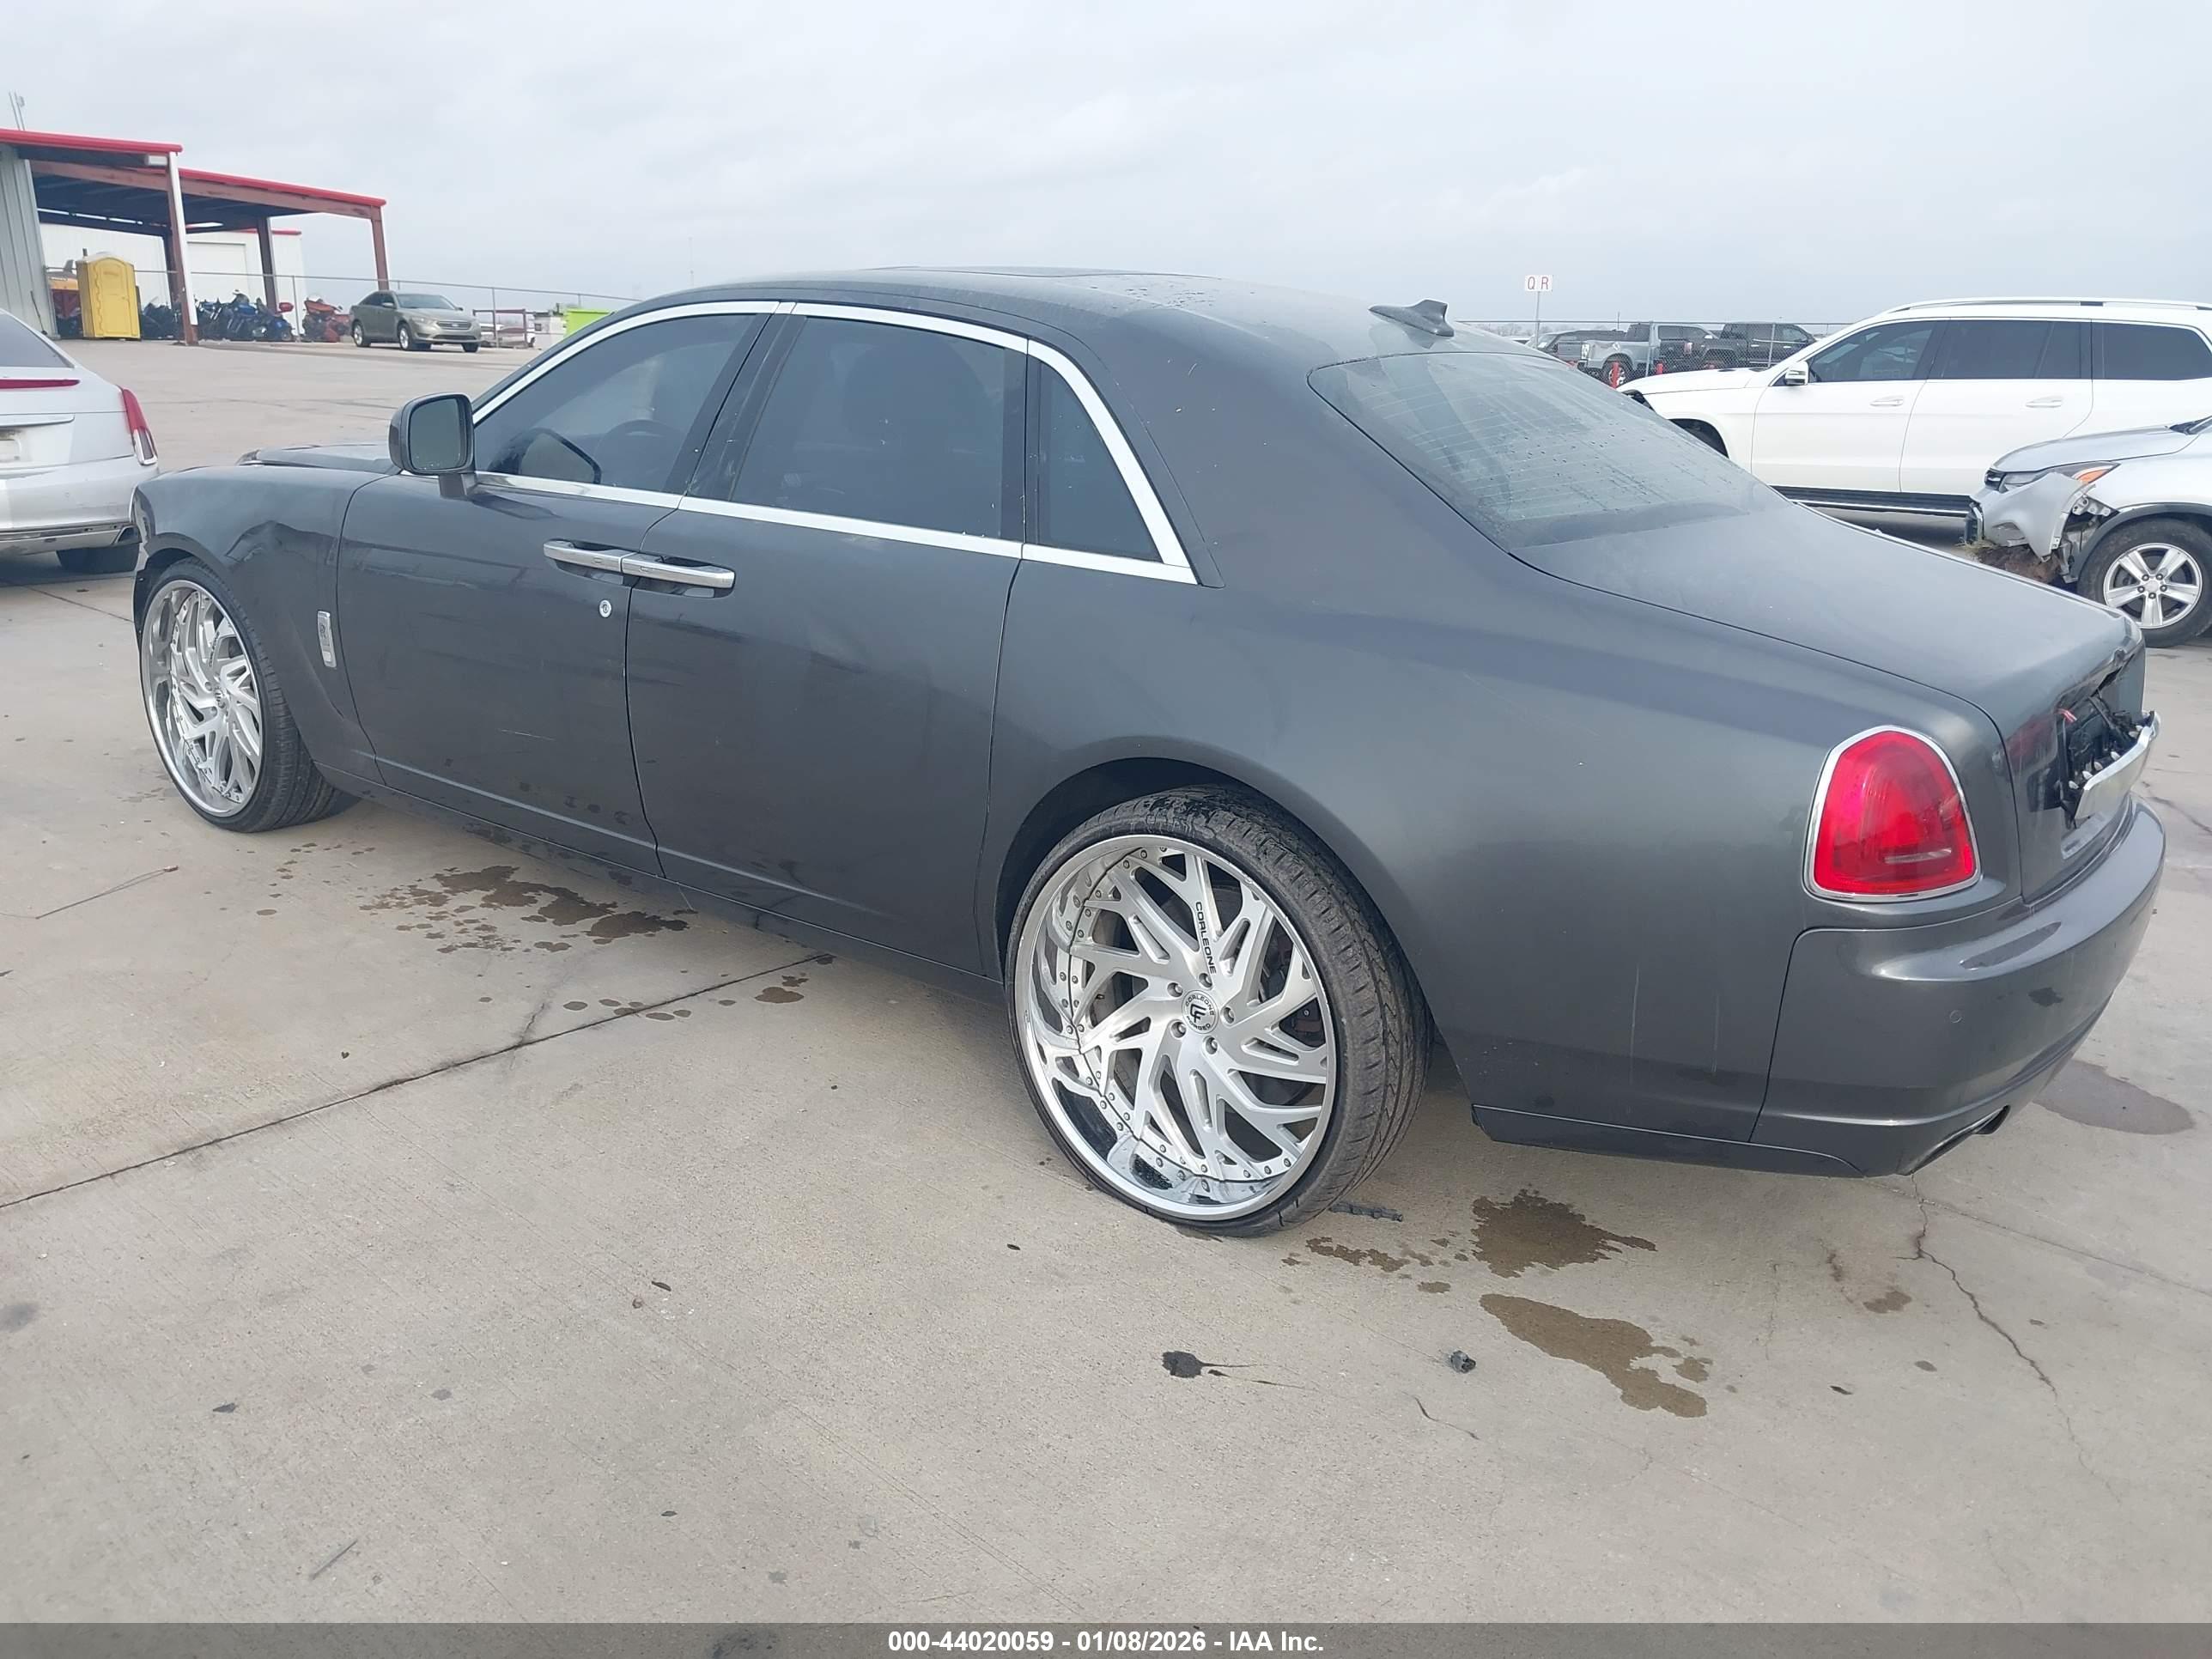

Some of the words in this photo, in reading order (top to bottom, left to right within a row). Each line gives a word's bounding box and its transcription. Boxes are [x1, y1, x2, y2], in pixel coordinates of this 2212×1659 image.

[1528, 276, 1535, 289] Q
[1540, 276, 1548, 289] R
[1195, 902, 1217, 975] CORLEONE
[1185, 994, 1215, 1016] CORLEONE
